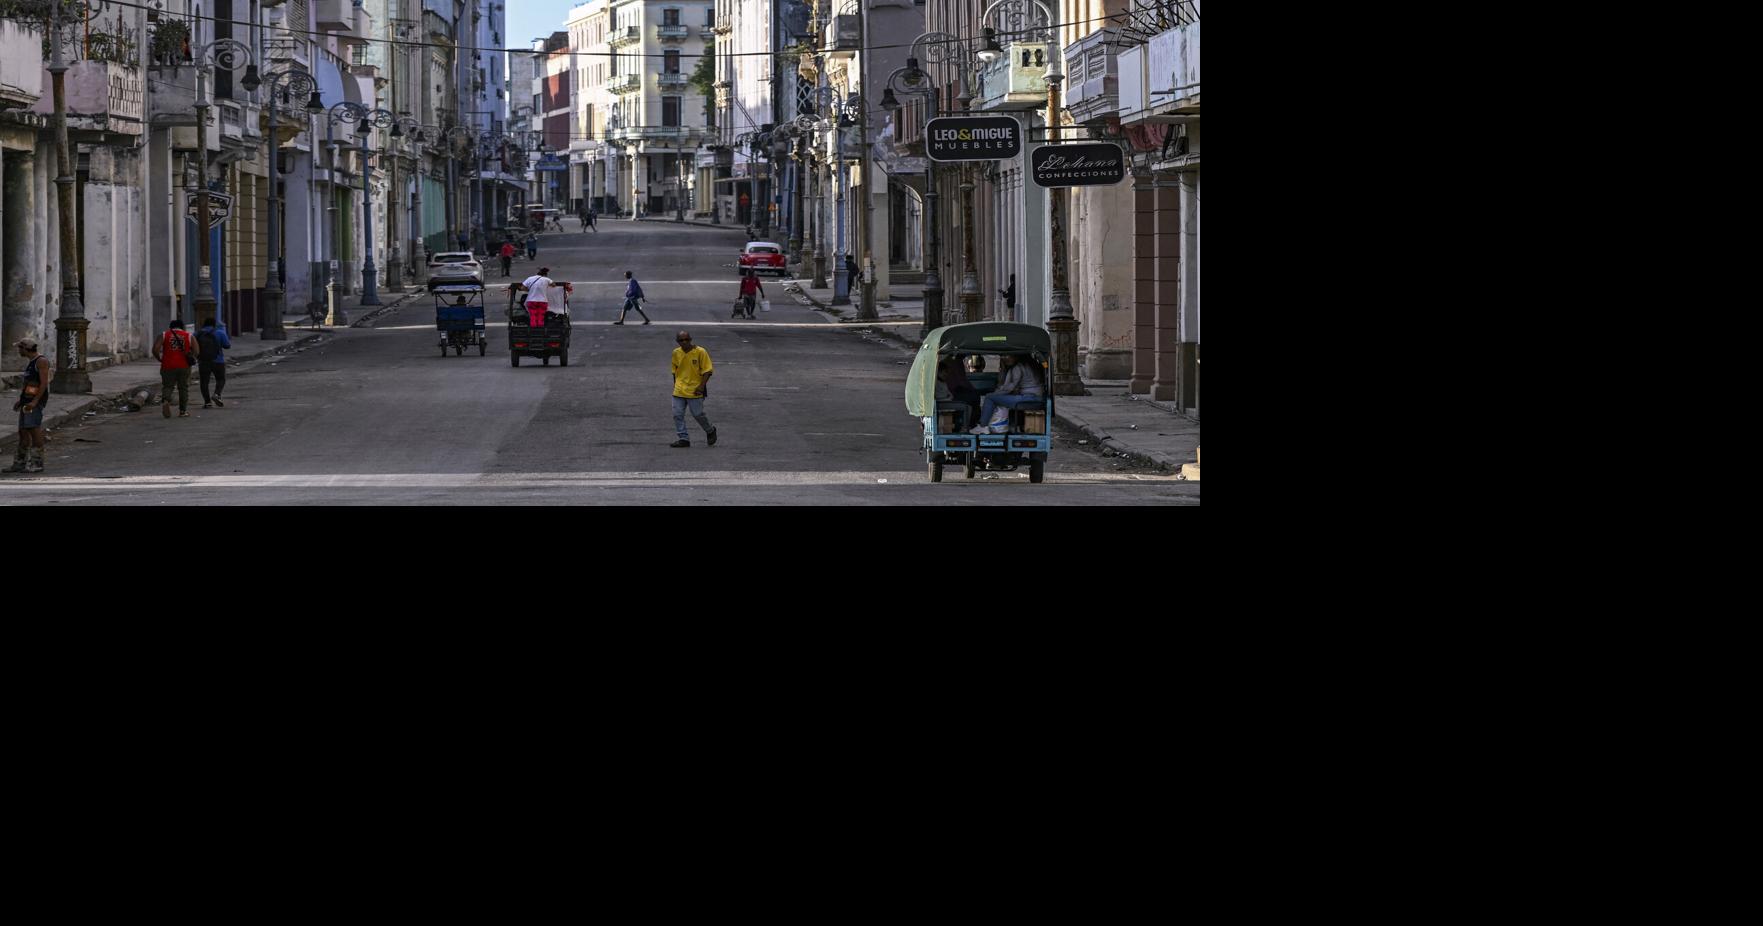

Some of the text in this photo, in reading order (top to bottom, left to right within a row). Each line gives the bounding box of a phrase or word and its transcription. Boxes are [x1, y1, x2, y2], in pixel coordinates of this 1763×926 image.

[934, 127, 1013, 141] LEO&MIGUE
[934, 141, 1014, 150] MUEBLES
[1038, 170, 1119, 179] CONFECCIONES
